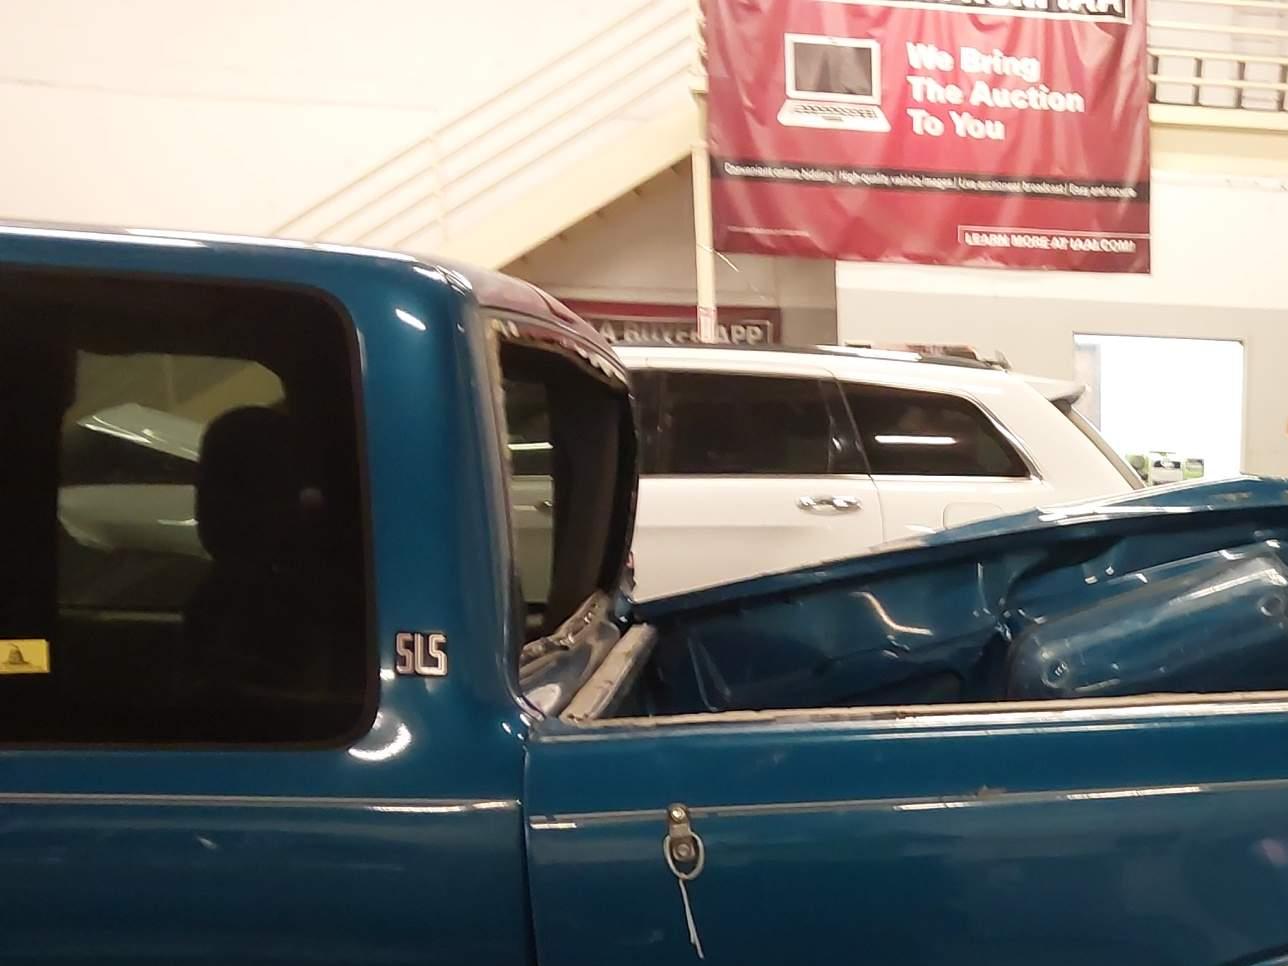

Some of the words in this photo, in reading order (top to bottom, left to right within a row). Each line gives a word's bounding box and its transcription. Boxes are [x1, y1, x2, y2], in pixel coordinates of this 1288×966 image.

[906, 41, 954, 71] We
[960, 47, 1040, 83] Bring
[906, 75, 964, 104] The
[969, 80, 1085, 112] Auction
[906, 108, 944, 136] To
[949, 111, 1006, 140] You
[964, 231, 1010, 248] LEARN
[1011, 233, 1050, 250] MORE
[1050, 235, 1068, 250] AT
[717, 324, 764, 346] APP
[396, 632, 448, 675] SLS
